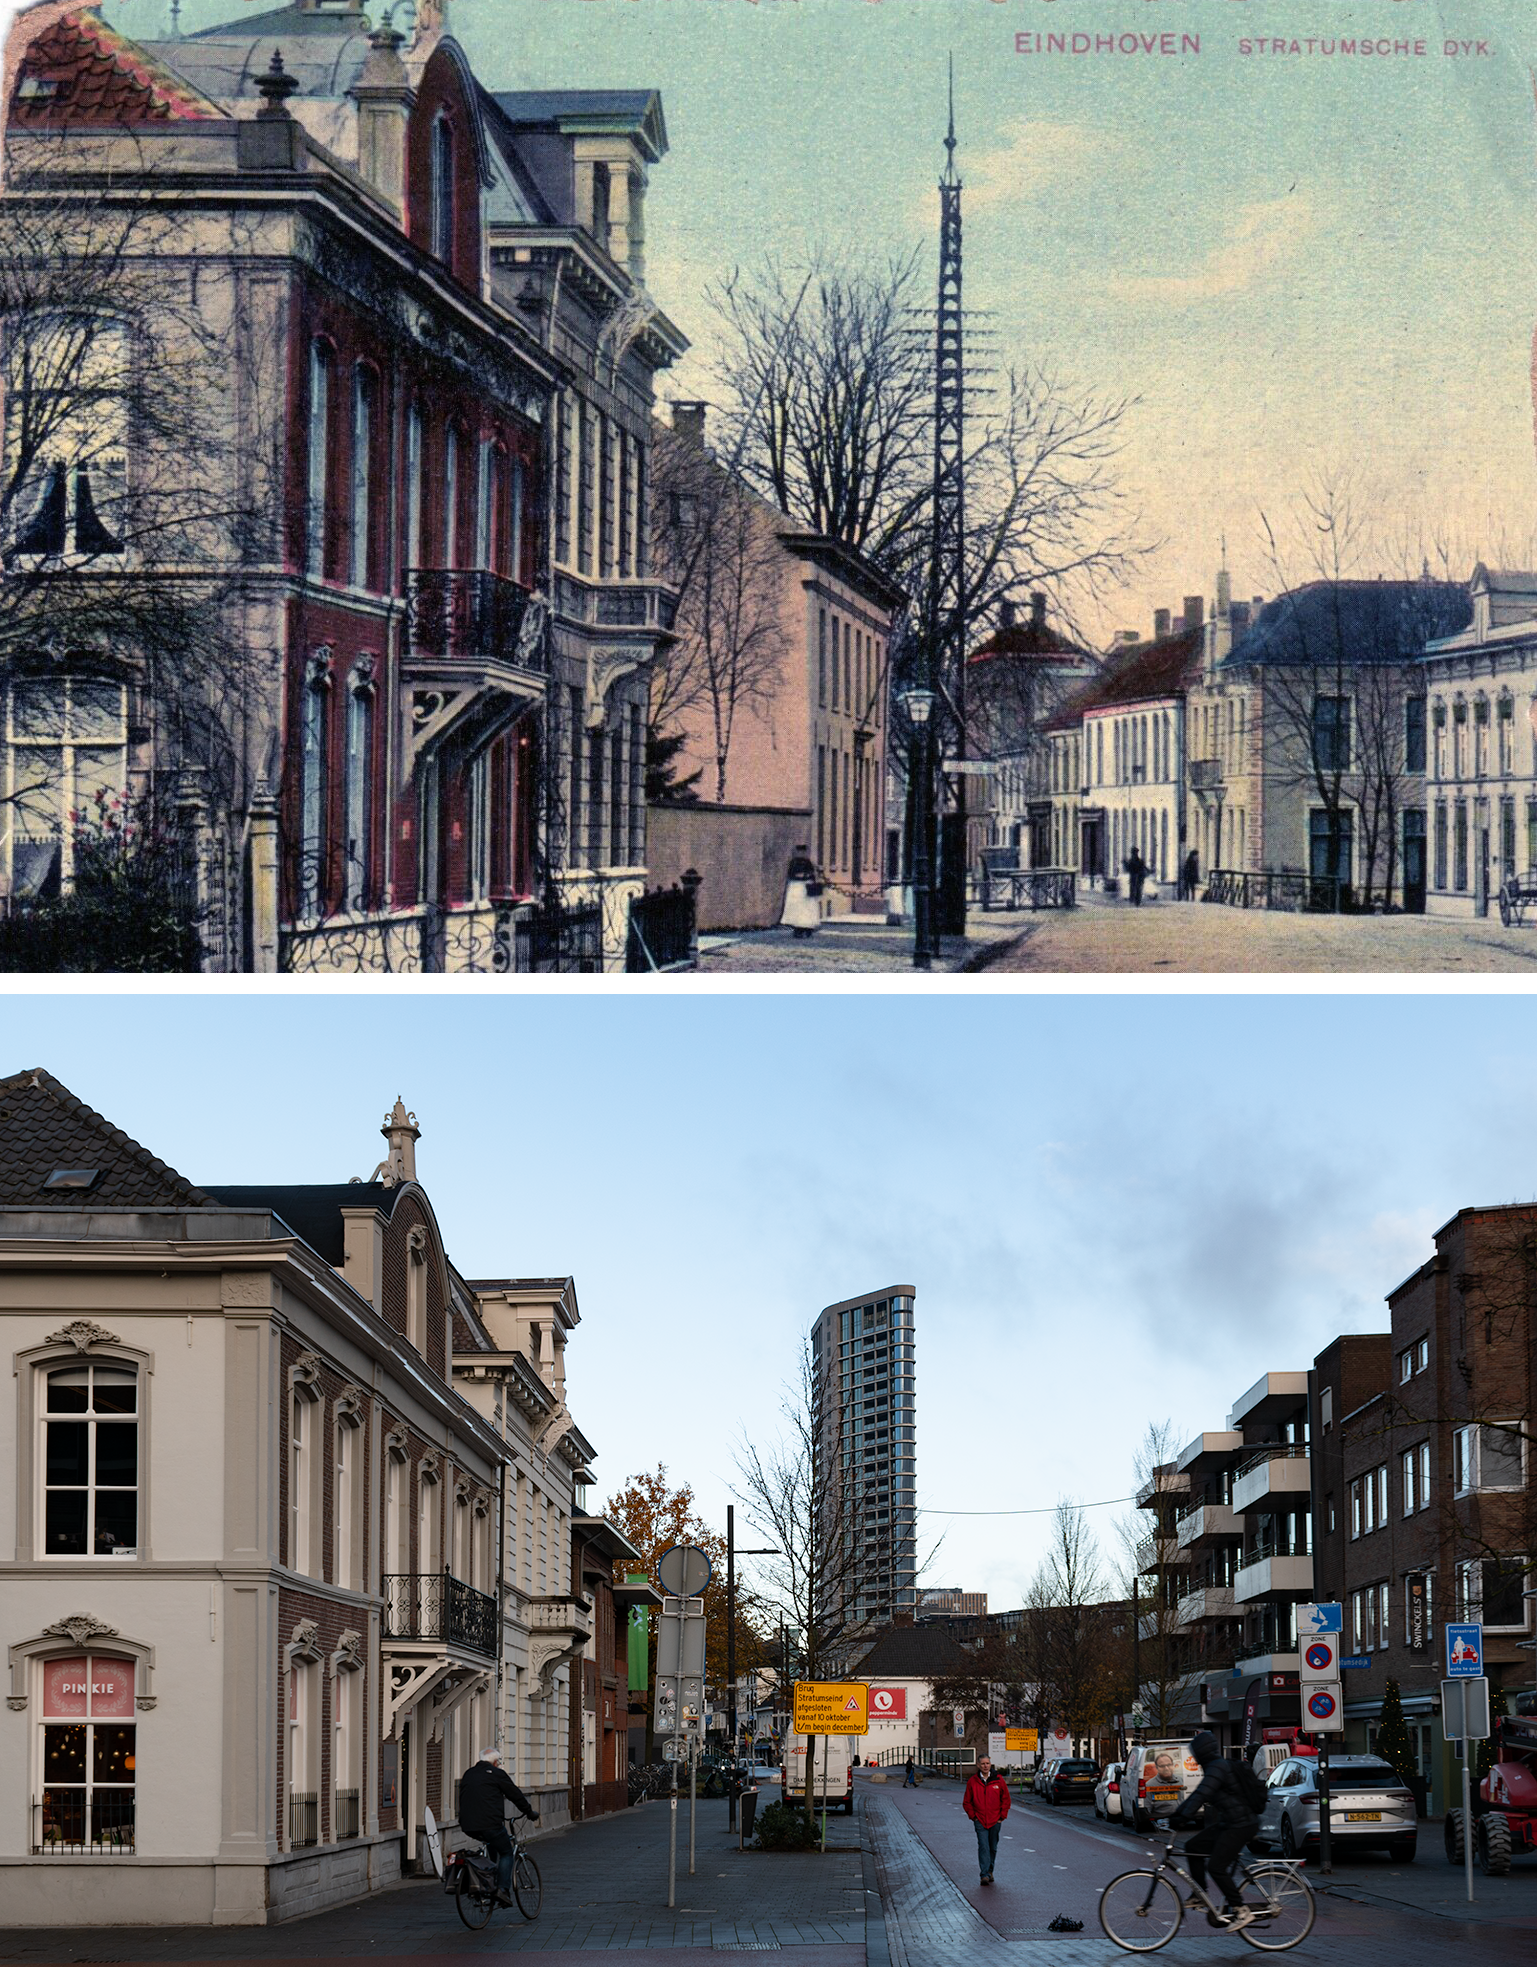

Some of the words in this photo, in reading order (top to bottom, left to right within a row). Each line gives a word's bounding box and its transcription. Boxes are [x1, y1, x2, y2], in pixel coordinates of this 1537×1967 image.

[62, 1683, 114, 1694] PINKIE
[798, 1685, 815, 1694] Brug
[798, 1694, 843, 1702] Stratumseind
[797, 1704, 832, 1713] afgesloten
[797, 1713, 817, 1721] vanaf
[825, 1713, 851, 1721] oktober
[797, 1723, 812, 1731] t/m
[812, 1723, 831, 1732] begin
[831, 1723, 865, 1732] december
